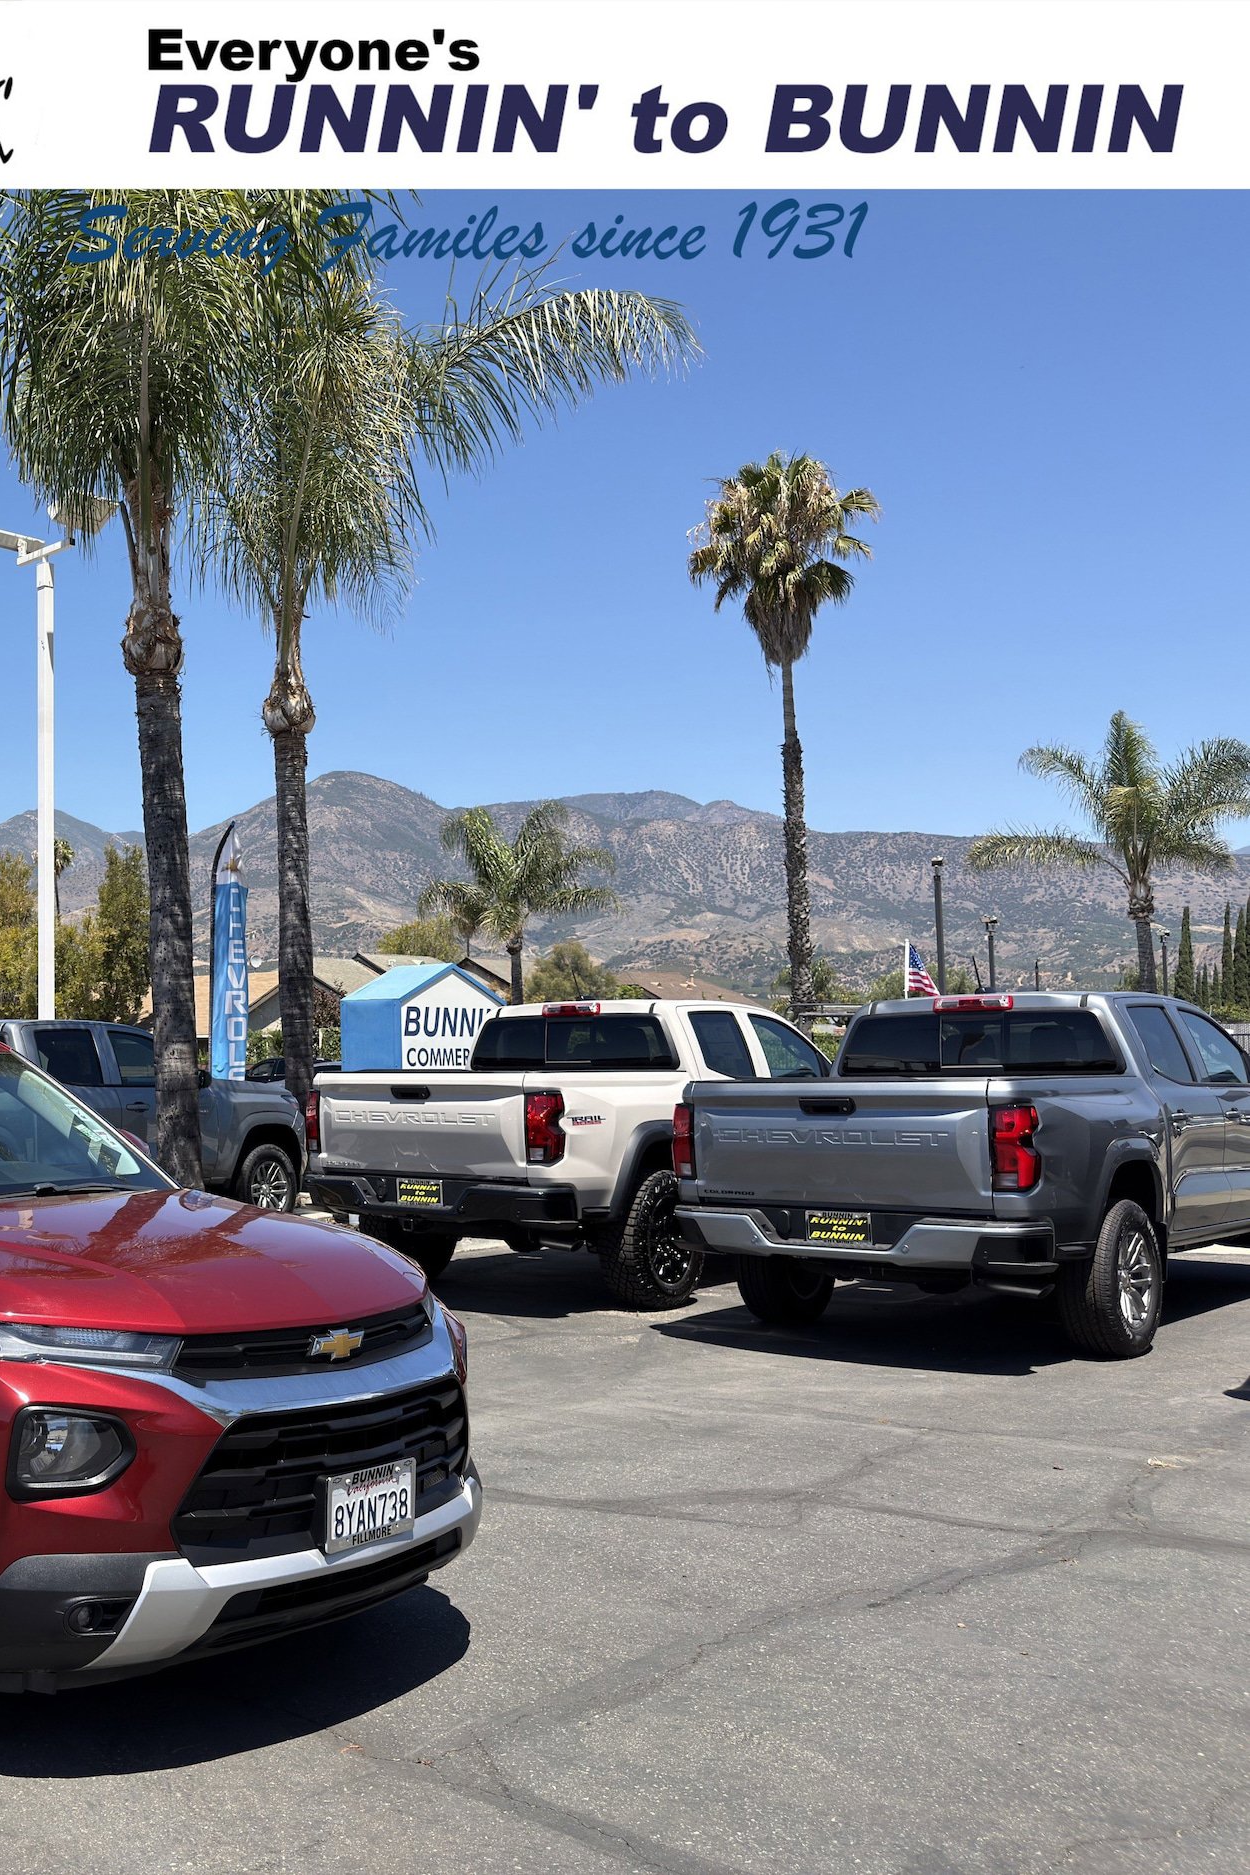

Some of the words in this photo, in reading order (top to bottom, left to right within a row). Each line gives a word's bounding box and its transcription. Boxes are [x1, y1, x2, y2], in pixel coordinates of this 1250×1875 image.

[404, 1006, 492, 1037] BUNNI
[334, 1110, 496, 1127] CHEVROLET
[716, 1128, 949, 1147] CHEVROLET
[399, 1194, 439, 1203] BUNNIN
[810, 1216, 867, 1227] RUNNIN'
[810, 1230, 866, 1241] BUNNIN
[352, 1463, 395, 1485] BUNNIN
[334, 1487, 408, 1539] 8YAN738
[352, 1524, 392, 1546] FILLMORE
